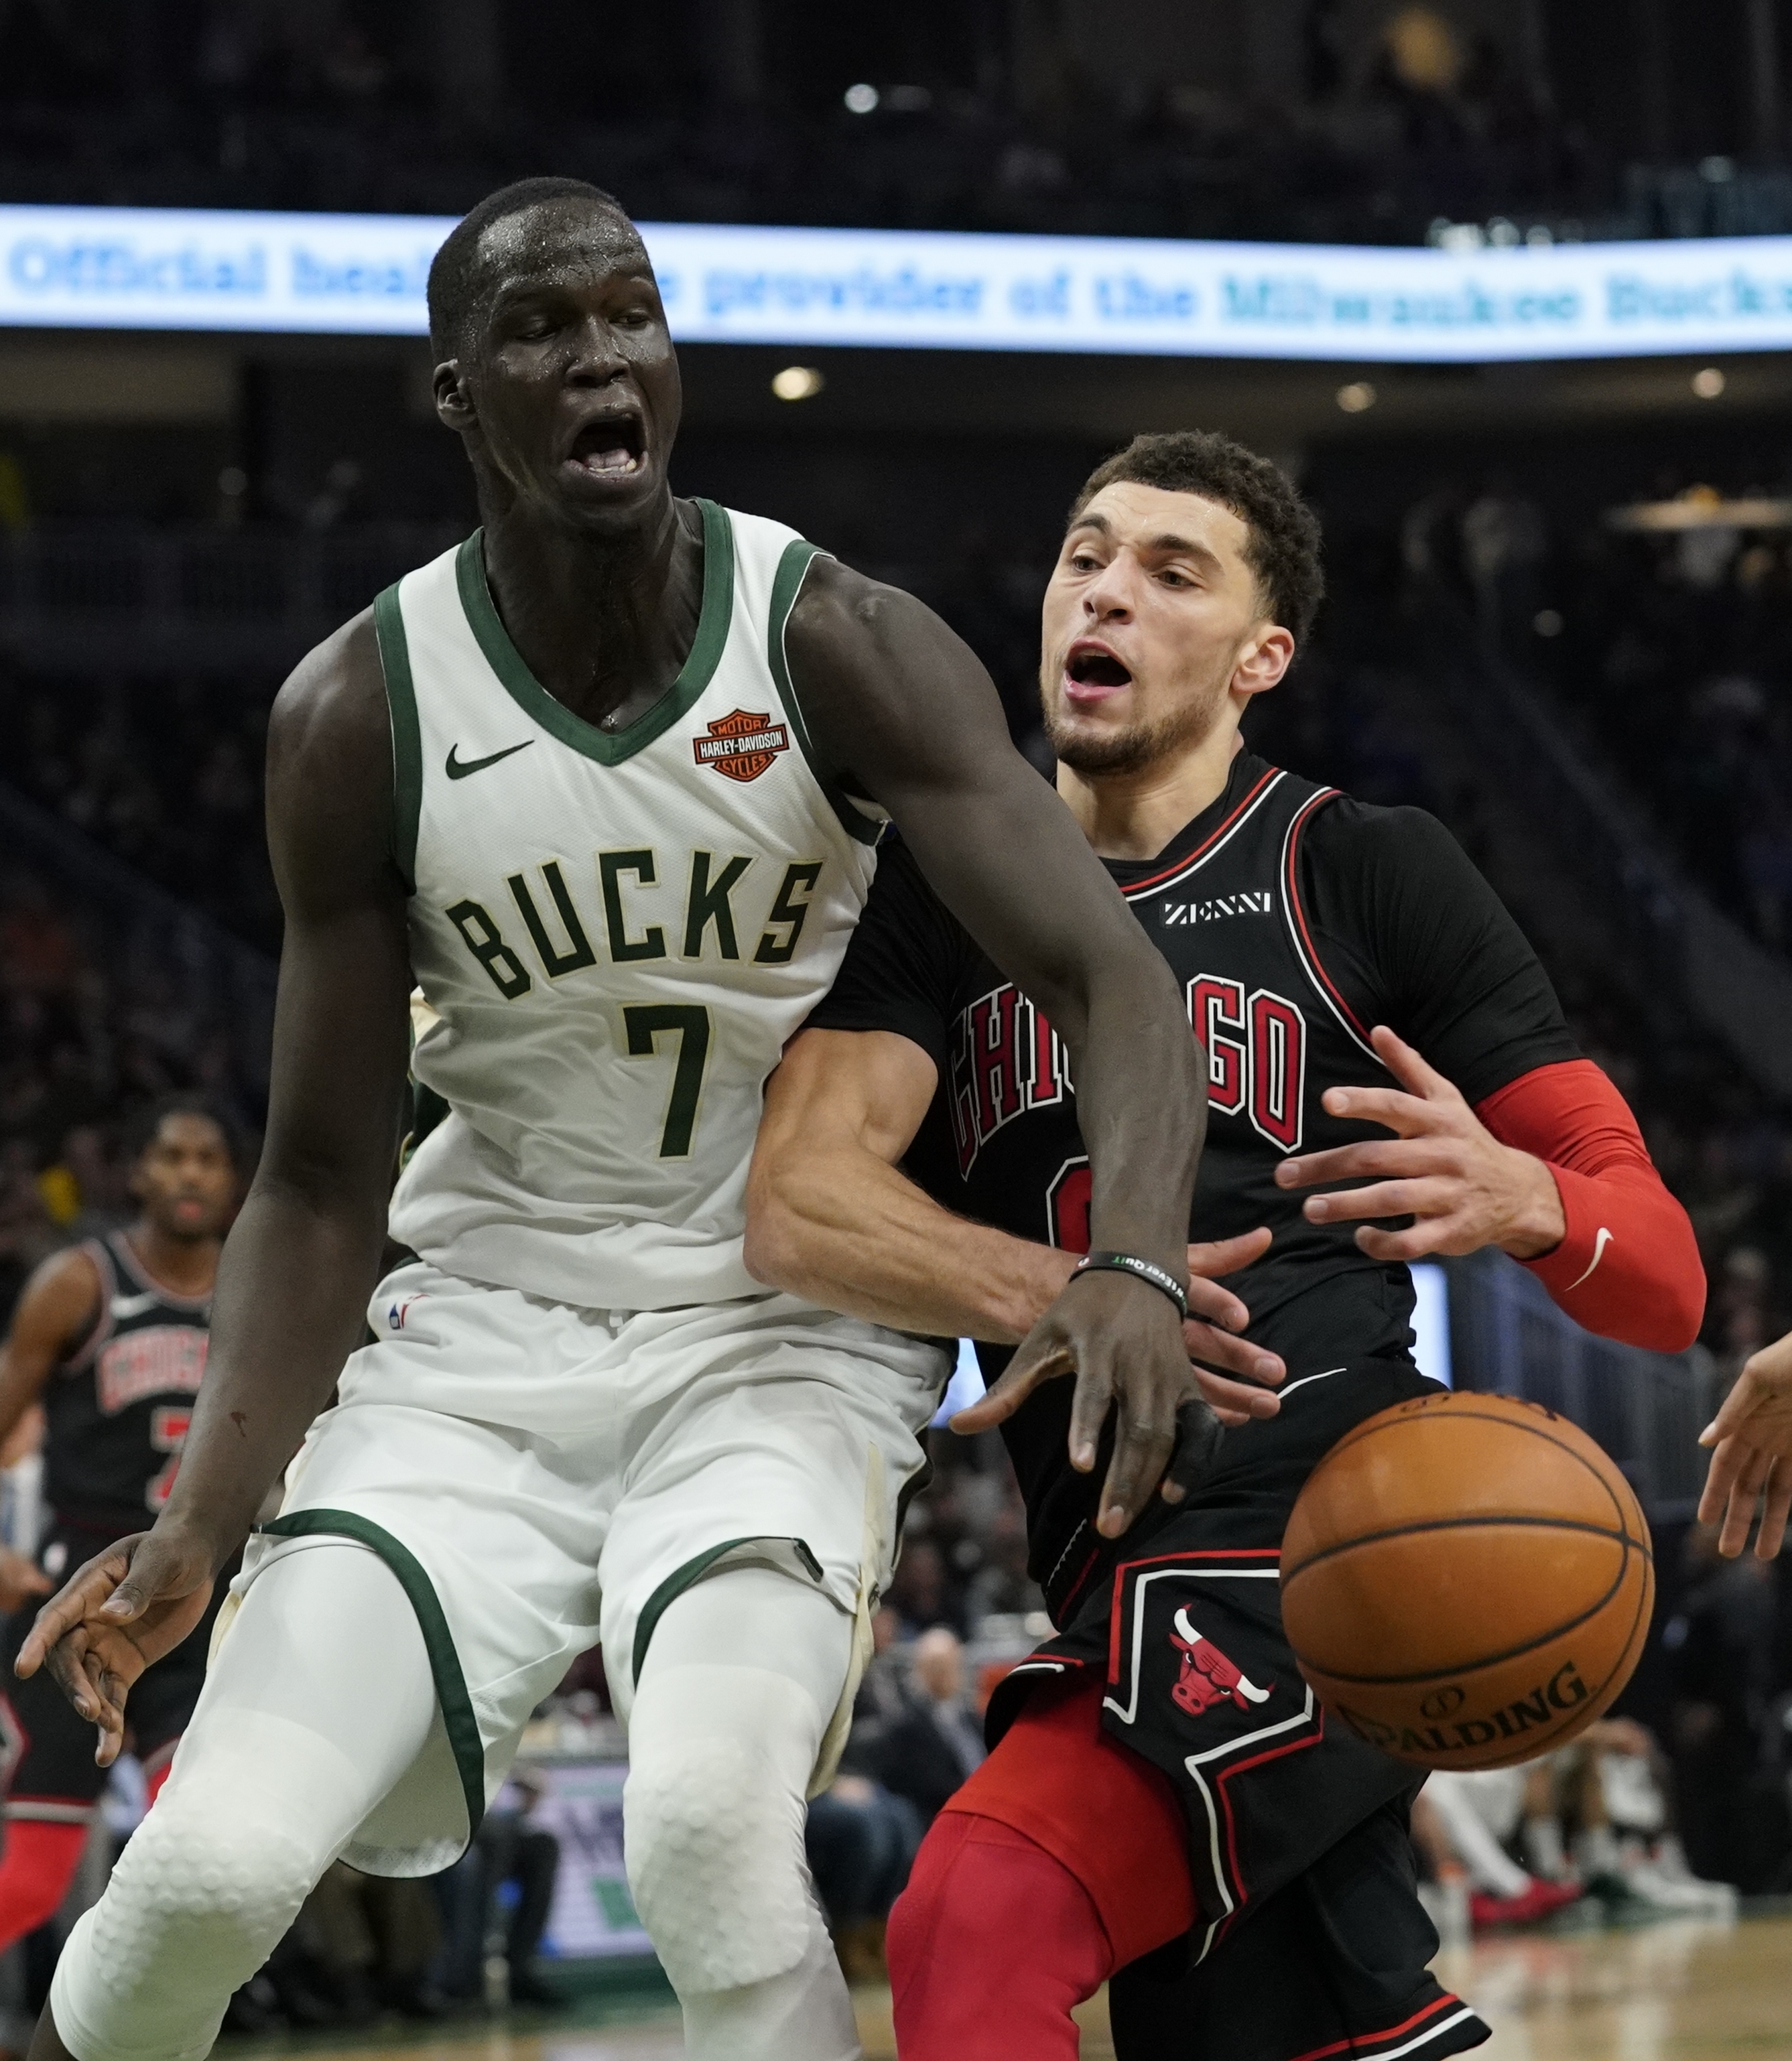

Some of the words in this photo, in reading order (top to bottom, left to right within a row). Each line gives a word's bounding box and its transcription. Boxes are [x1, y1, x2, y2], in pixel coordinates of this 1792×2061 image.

[7, 236, 265, 296] Official
[702, 256, 985, 319] provider
[1009, 263, 1070, 316] of
[1094, 268, 1198, 320] the
[1220, 273, 1582, 326] Milwaukee
[700, 730, 783, 759] HARLEY-DAVIDSON
[718, 716, 762, 735] MOTOR
[721, 754, 767, 777] CYCLES
[443, 846, 824, 1002] BUCKS
[1165, 892, 1271, 925] ZENNI
[618, 1004, 715, 1163] 7
[946, 973, 1306, 1182] CHIGO
